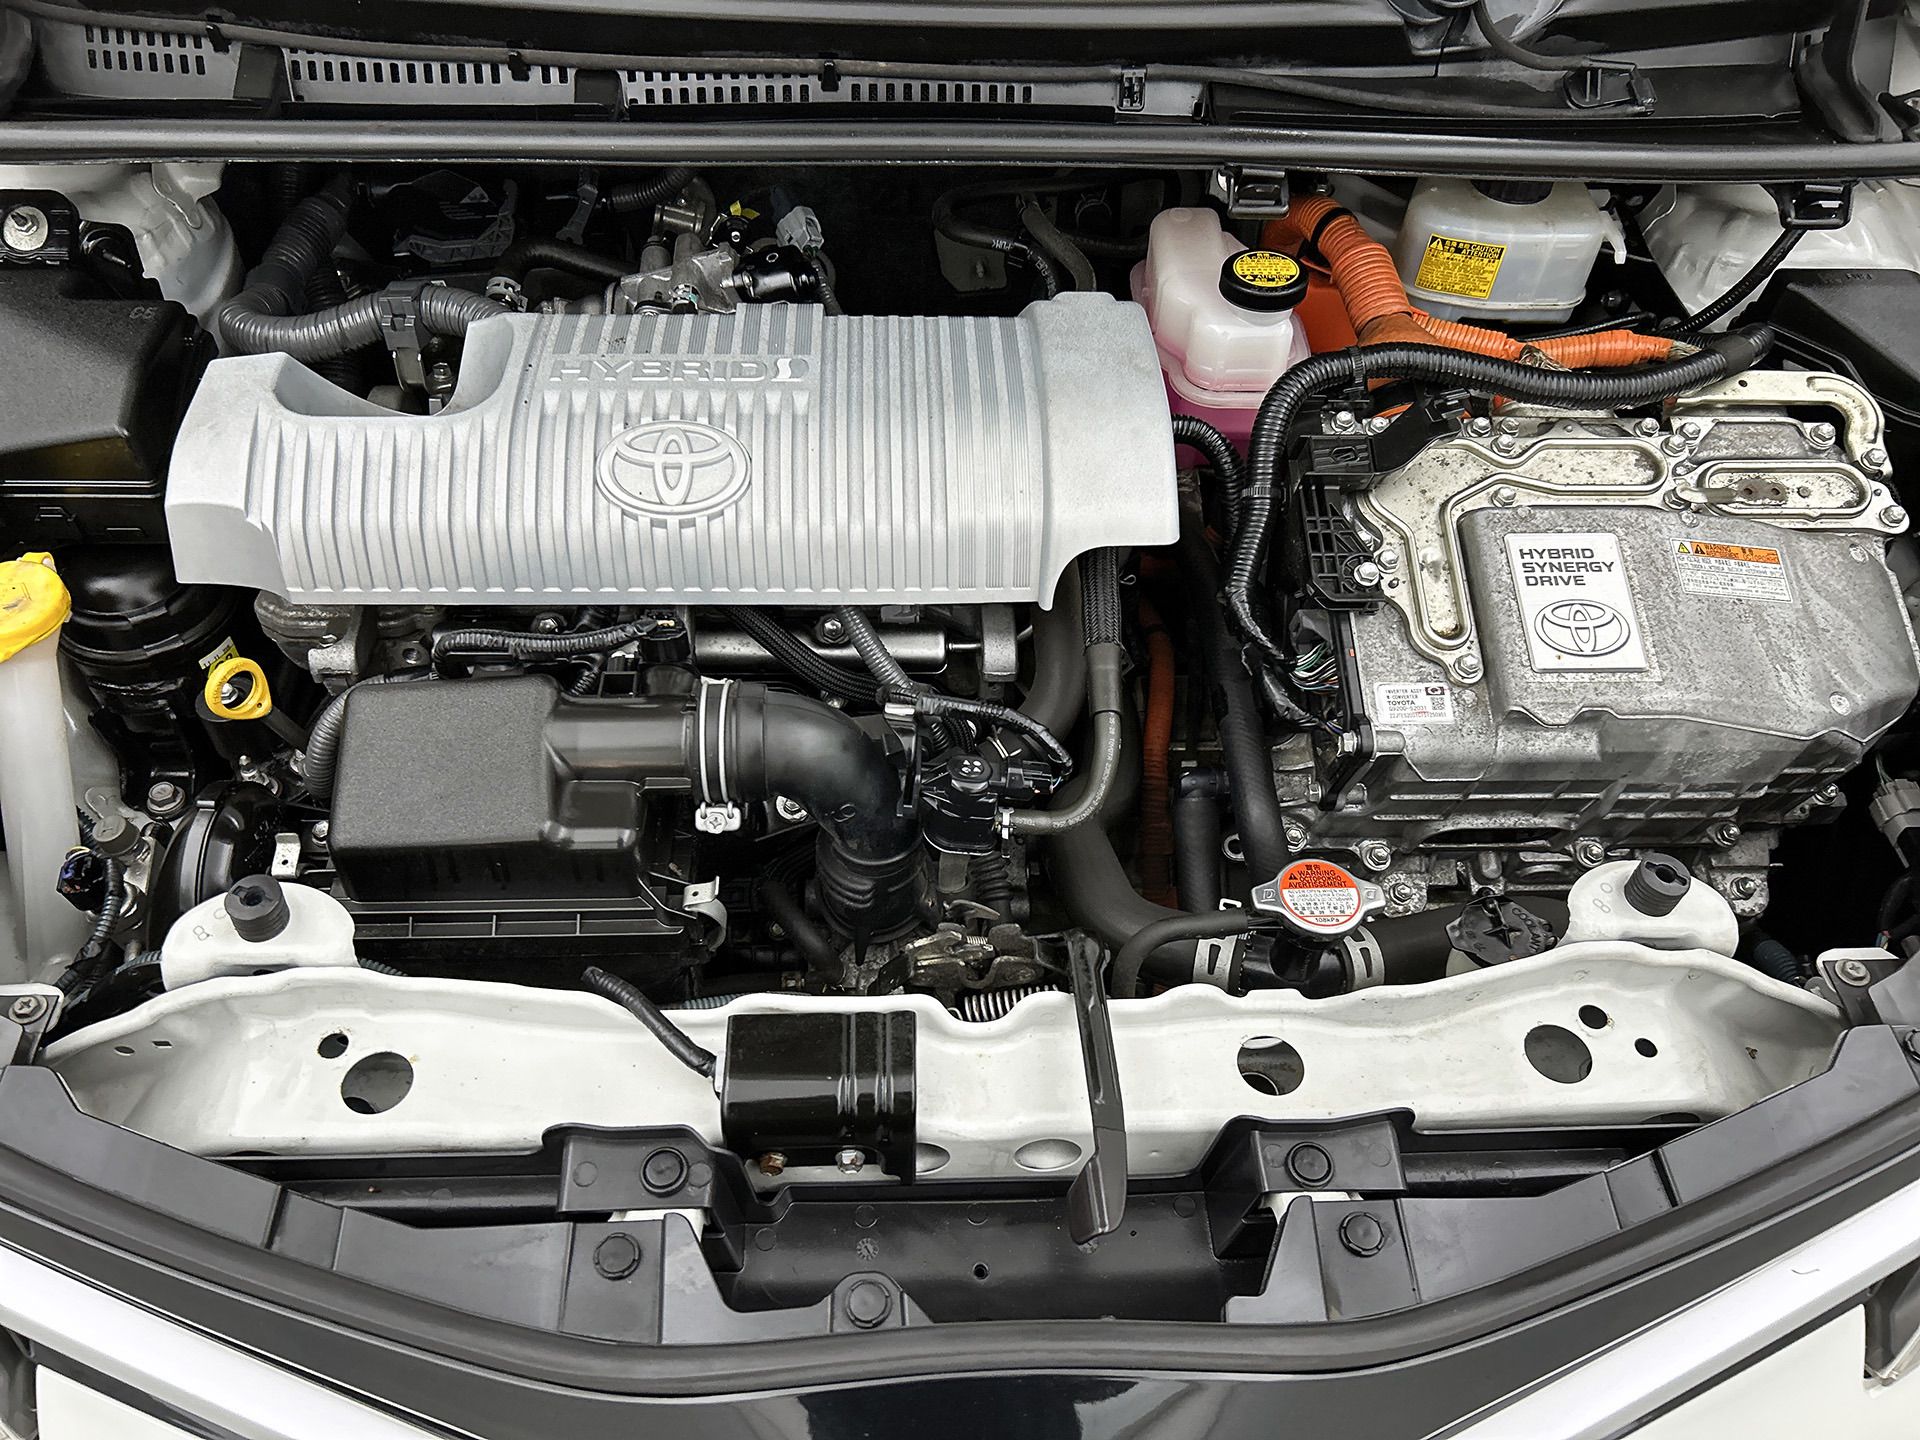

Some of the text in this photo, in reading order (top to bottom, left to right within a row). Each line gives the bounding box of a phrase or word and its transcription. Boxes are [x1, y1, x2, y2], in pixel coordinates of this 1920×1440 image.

[1461, 249, 1500, 259] ATTENTION
[1471, 244, 1501, 254] CAUTION
[549, 360, 768, 382] HYBRID
[1518, 548, 1595, 559] HYBRID
[1522, 561, 1614, 573] SYNERGY
[1525, 575, 1586, 586] DRIVE
[1297, 869, 1336, 877] WARNING
[1289, 880, 1347, 888] AVERTISSEMENT
[1511, 907, 1542, 952] COOLANT
